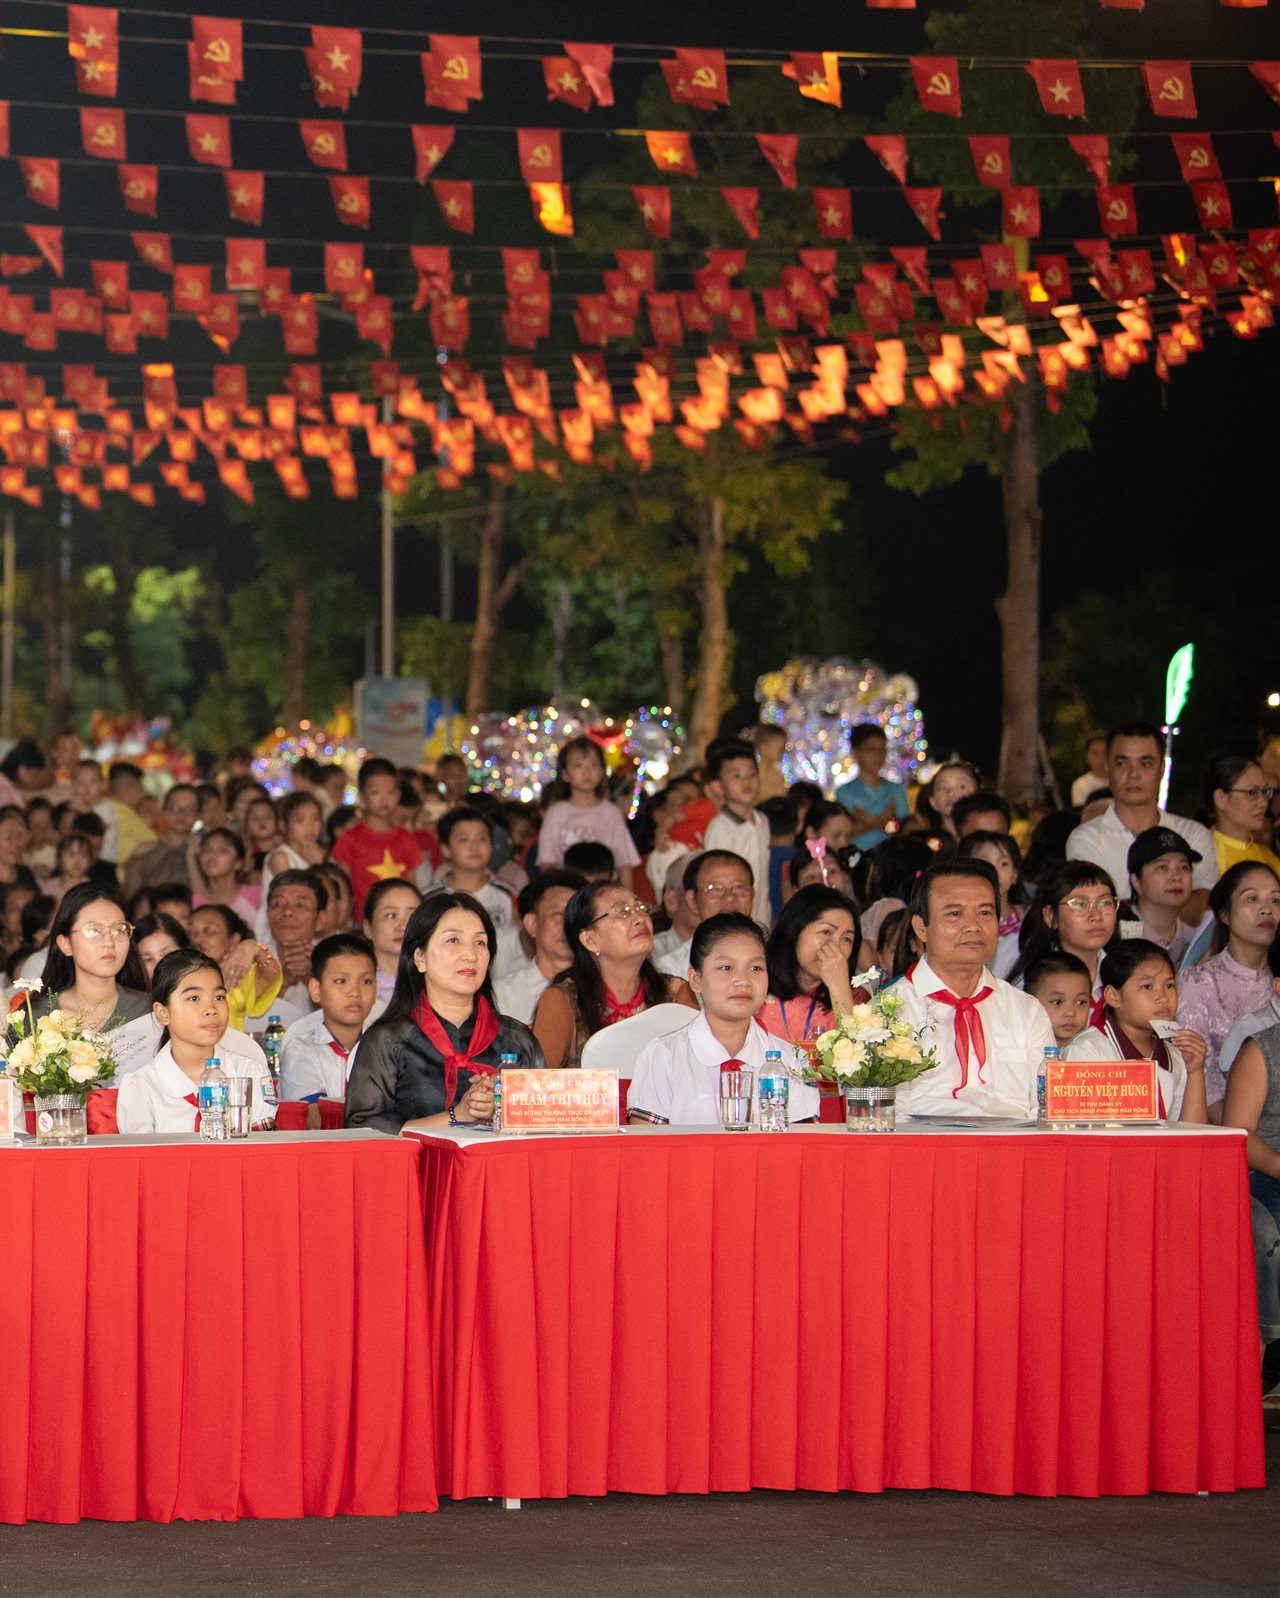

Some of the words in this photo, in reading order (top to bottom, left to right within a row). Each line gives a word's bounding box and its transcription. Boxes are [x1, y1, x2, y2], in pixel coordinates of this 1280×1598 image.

[1108, 1070, 1126, 1078] CHÍ
[1053, 1079, 1094, 1097] NGUYỄN
[1095, 1082, 1118, 1099] VIỆT
[1120, 1081, 1148, 1096] HÙNG
[512, 1094, 546, 1108] PHẠM
[550, 1094, 571, 1108] THỊ
